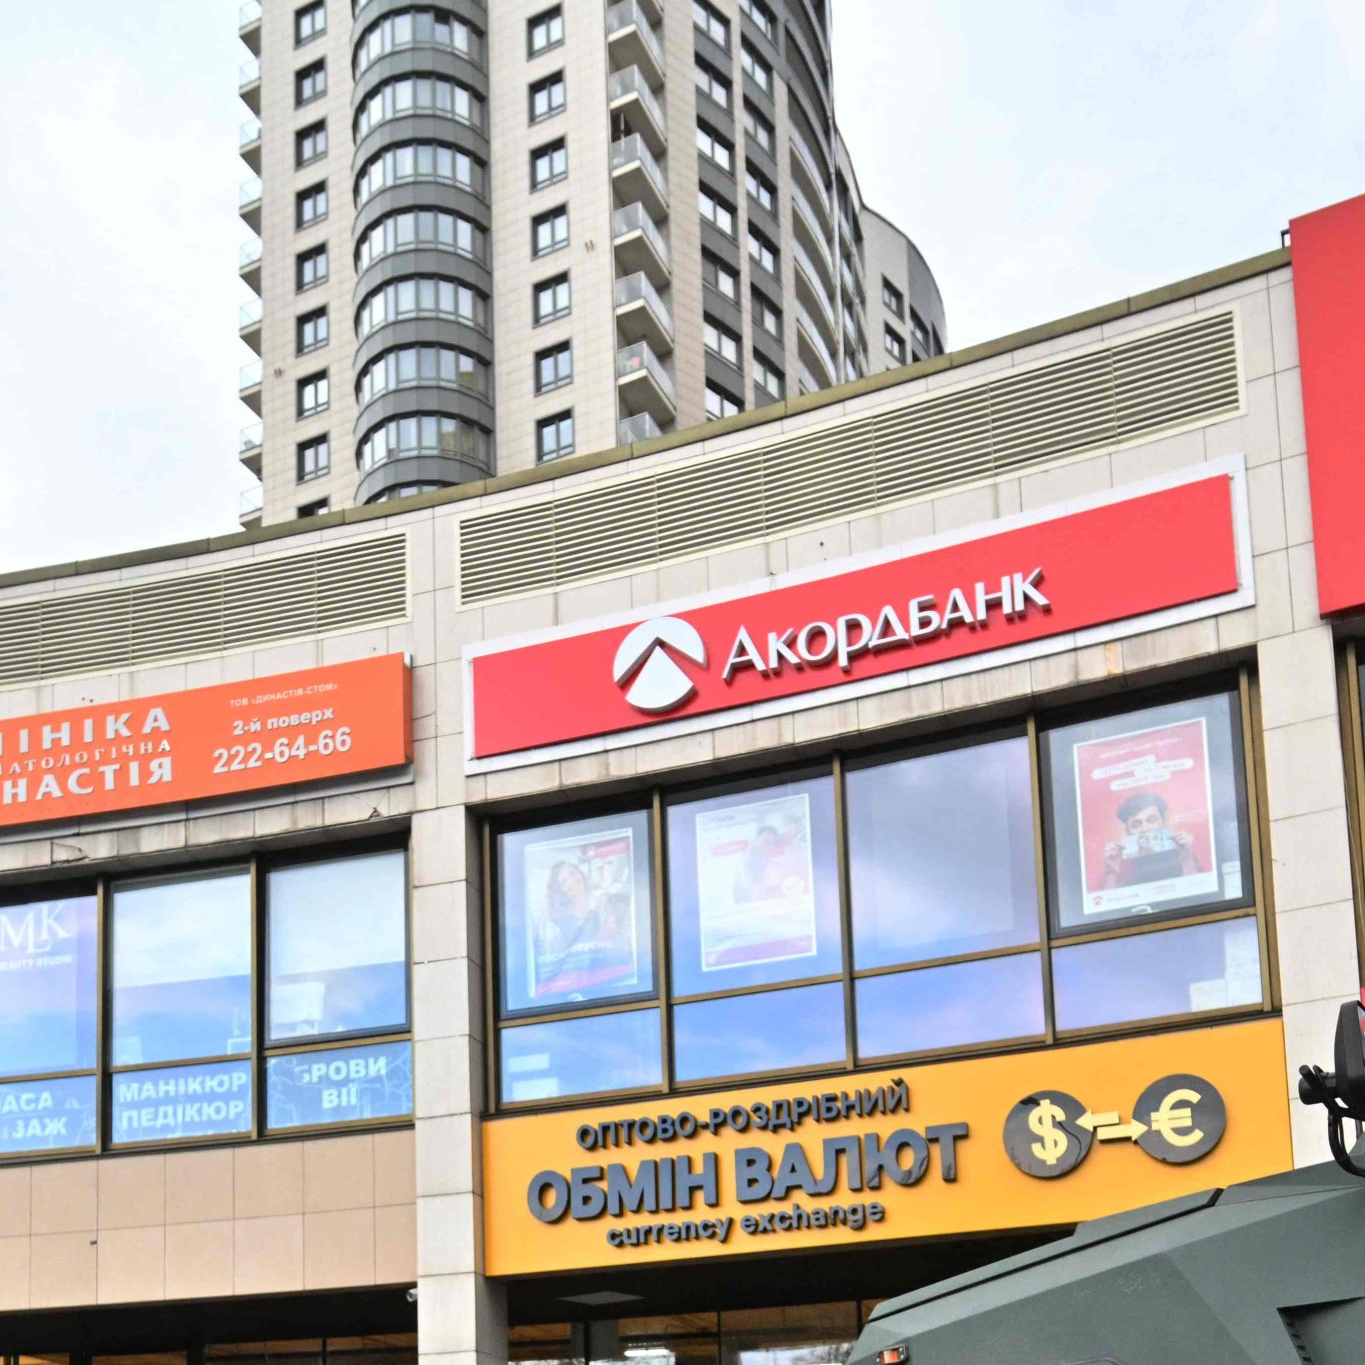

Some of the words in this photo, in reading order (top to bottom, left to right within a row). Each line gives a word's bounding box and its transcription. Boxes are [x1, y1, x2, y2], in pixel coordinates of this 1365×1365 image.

[229, 697, 249, 708] ТОВ
[232, 717, 262, 736] 2-й
[267, 707, 334, 730] поверх
[212, 726, 352, 774] 222-64-66
[36, 953, 73, 967] STUDIO
[293, 1056, 387, 1084] БРОВИ
[118, 1072, 247, 1103] МАНІКЮР
[322, 1083, 358, 1109] ВІЇ
[121, 1101, 245, 1130] ПЕДІКЮР
[575, 1077, 911, 1151] ОПТОВО-РОЗДРІБНИЙ
[526, 1157, 720, 1224] ОБМІН
[735, 1121, 969, 1203] ВАЛЮТ
[606, 1210, 731, 1247] currency
[739, 1198, 886, 1234] exchange
